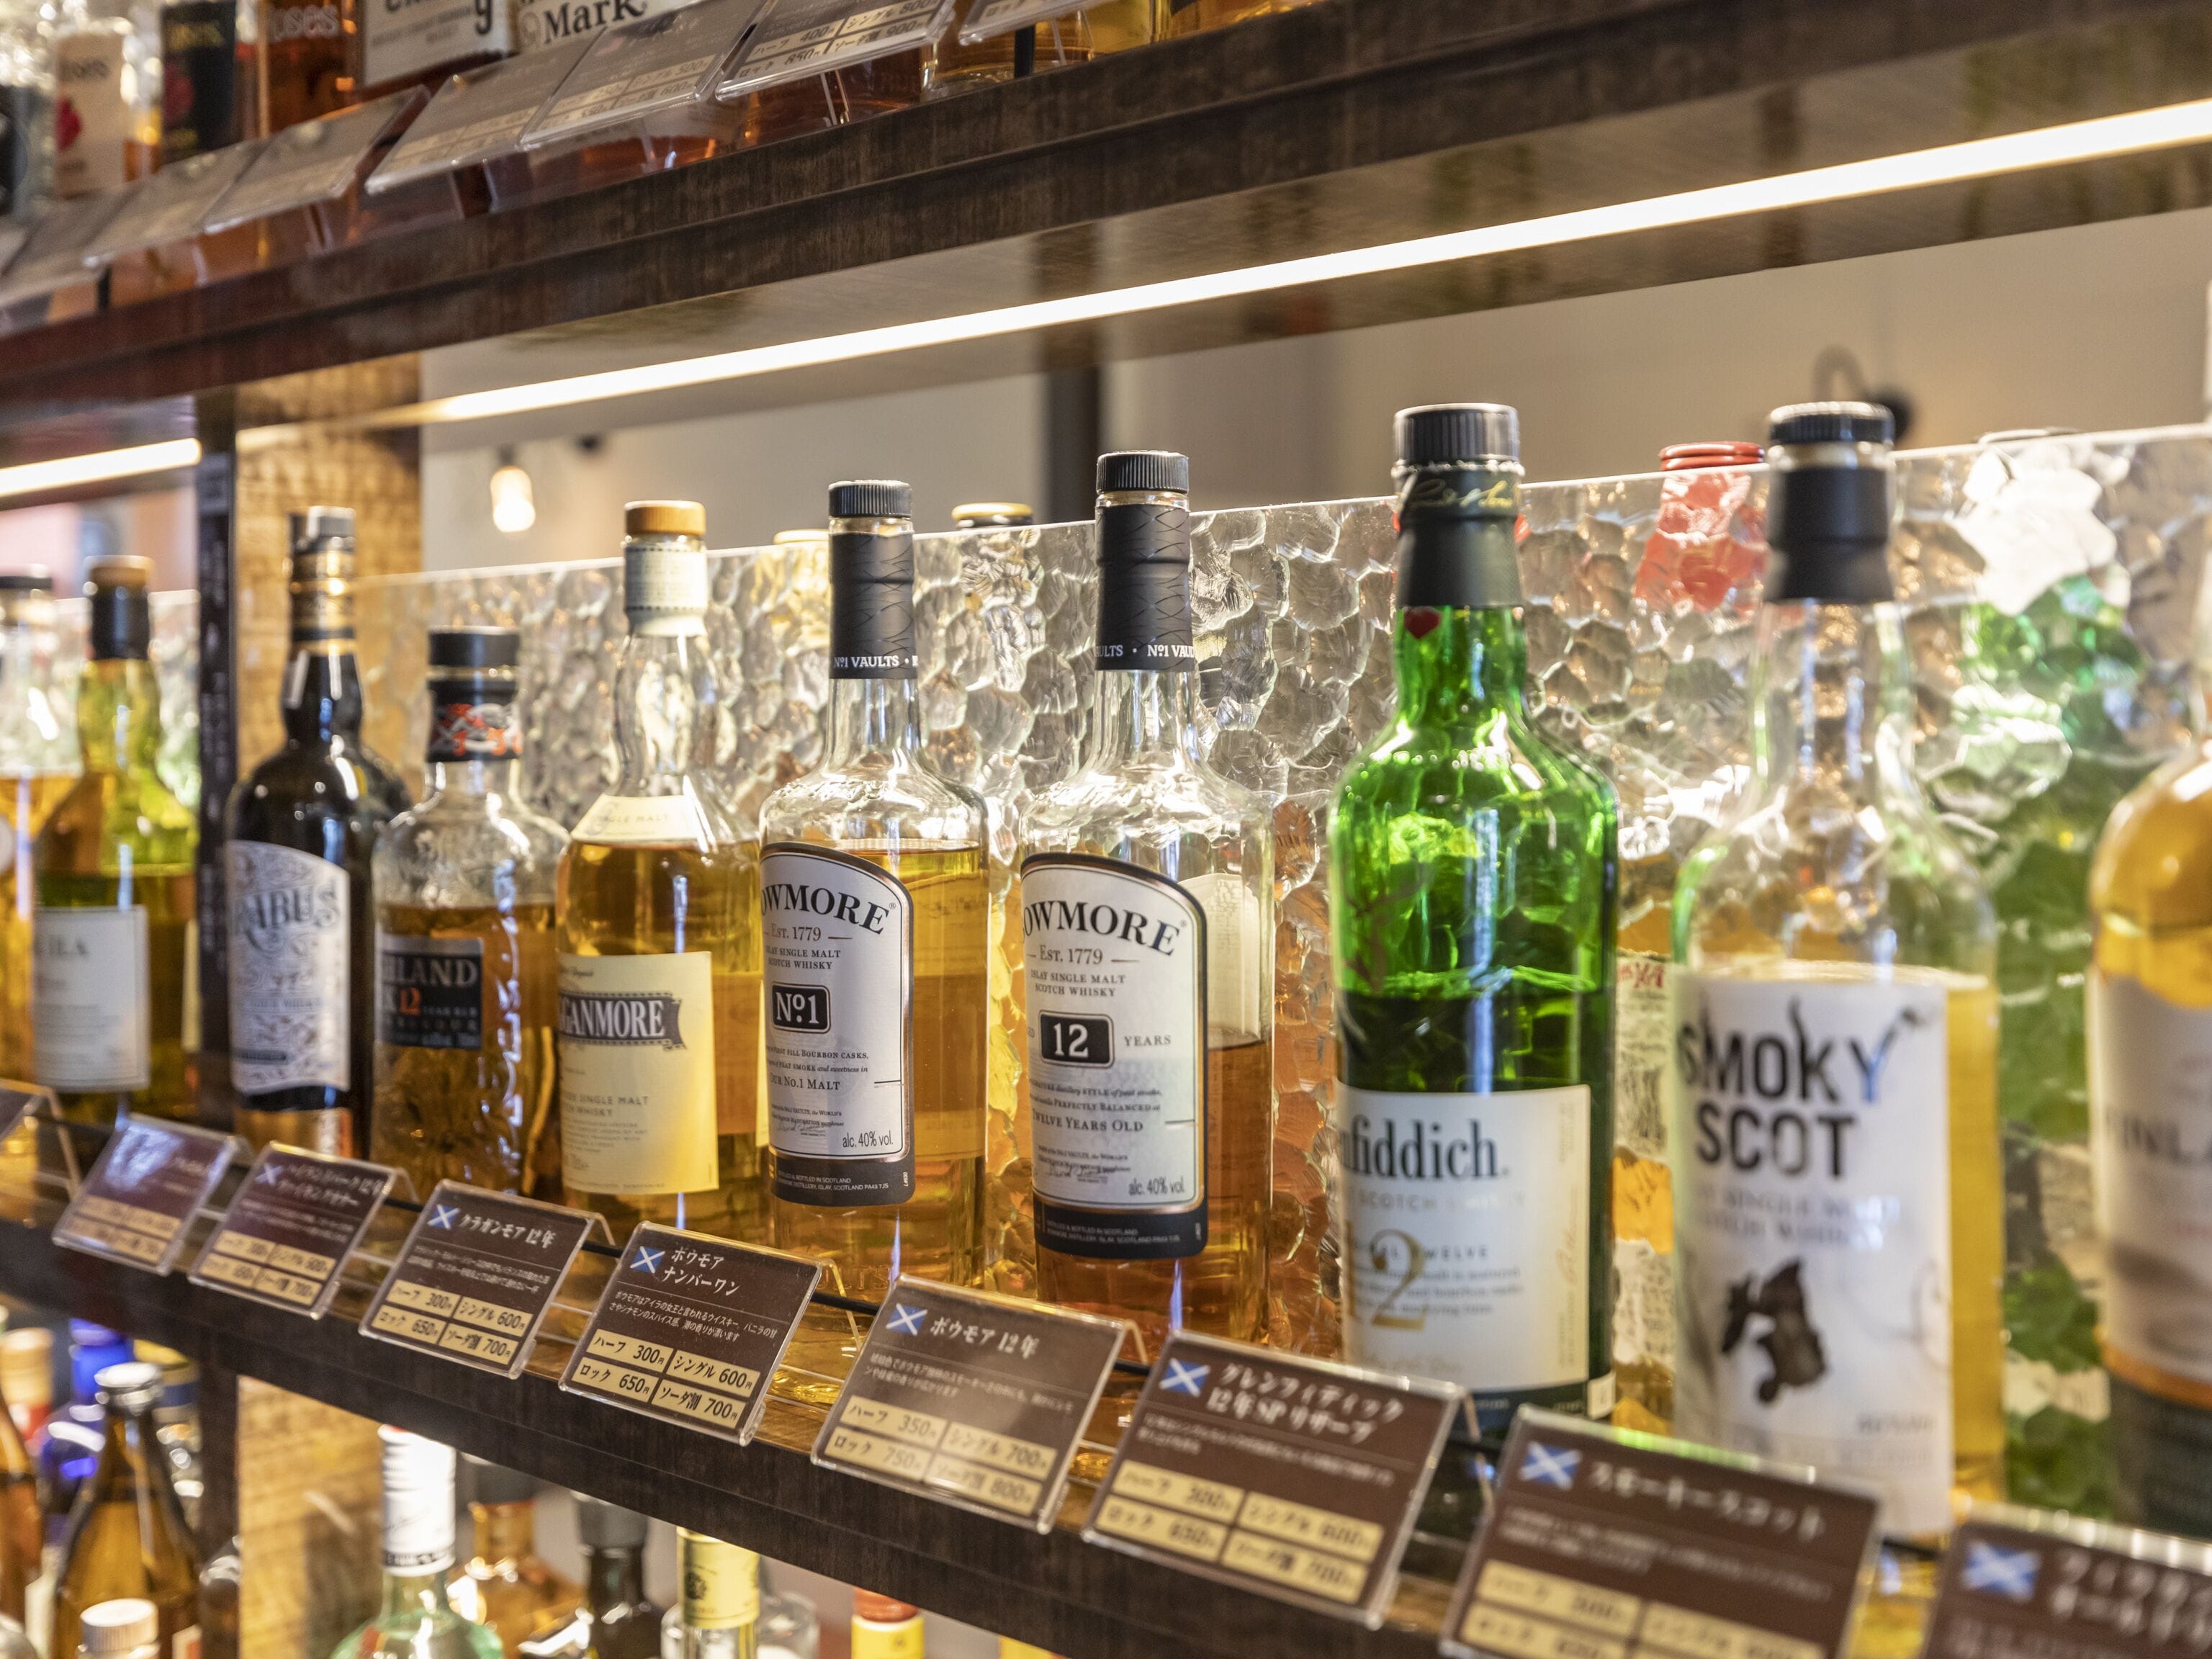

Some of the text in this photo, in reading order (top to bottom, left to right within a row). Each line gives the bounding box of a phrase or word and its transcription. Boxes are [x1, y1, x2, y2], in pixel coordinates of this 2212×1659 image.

[850, 655, 899, 668] VAULTS
[792, 926, 822, 942] 1779
[1022, 900, 1180, 957] OWMORE
[780, 948, 808, 958] SINGLE
[811, 949, 841, 958] MALT
[1068, 948, 1103, 965] 1779
[383, 956, 479, 988] LAND
[768, 958, 833, 970] SCOTCH WHISKY
[1051, 972, 1087, 983] SINGLE
[1092, 974, 1126, 984] MALT
[1035, 984, 1116, 997] SCOTCH WHISKY
[1053, 1022, 1089, 1058] 12
[1124, 1035, 1172, 1047] YEARS
[801, 1049, 839, 1058] BOURBON
[793, 1063, 816, 1071] SMOKE
[807, 1079, 841, 1090] MALT
[618, 1095, 649, 1106] MALT
[1100, 1102, 1151, 1112] BALANCED
[1033, 1108, 1143, 1132] TWELVE YEARS OLD
[842, 1129, 894, 1148] alc. 40% vol.
[1694, 1102, 1858, 1180] SCOT
[671, 1246, 725, 1270] ボウモア
[661, 1266, 741, 1296] ナンバーワン
[930, 1316, 1041, 1361] ボウモア 12年
[593, 1336, 665, 1365] ハーフ 300円
[579, 1364, 651, 1395] ロック 650円
[673, 1355, 753, 1390] シングル 600円
[659, 1386, 739, 1421] ソーダ割 700円
[848, 1404, 889, 1424] ハーフ
